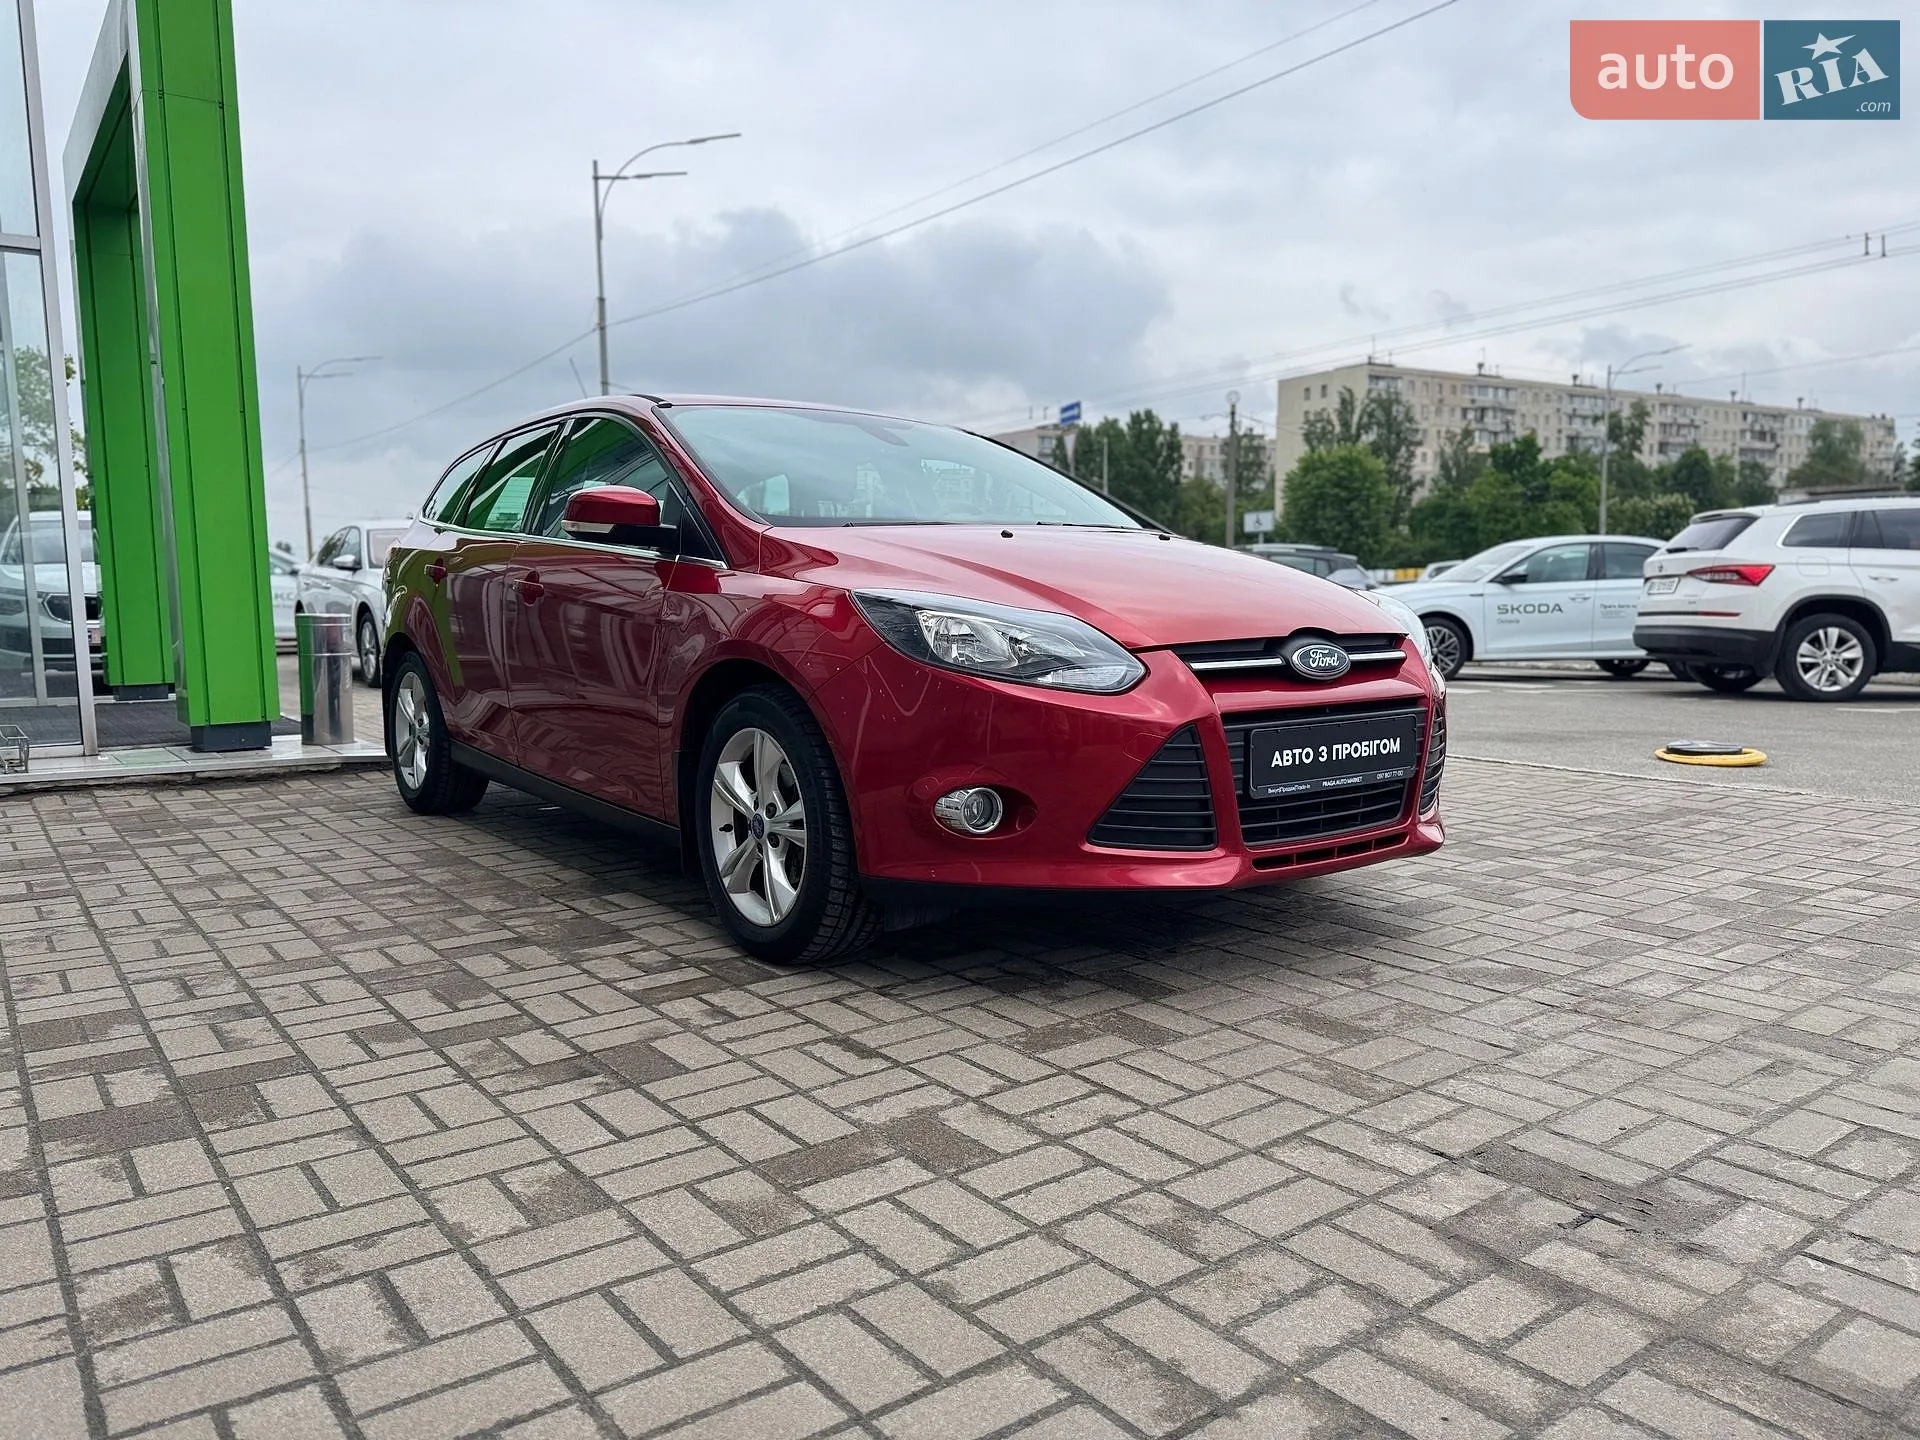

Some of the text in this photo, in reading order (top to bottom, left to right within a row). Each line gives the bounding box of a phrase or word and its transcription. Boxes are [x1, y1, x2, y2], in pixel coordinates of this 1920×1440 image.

[1309, 649, 1340, 668] Ford
[1271, 737, 1400, 768] АВТО З ПРОБІГОМ
[1347, 776, 1363, 784] MARKET
